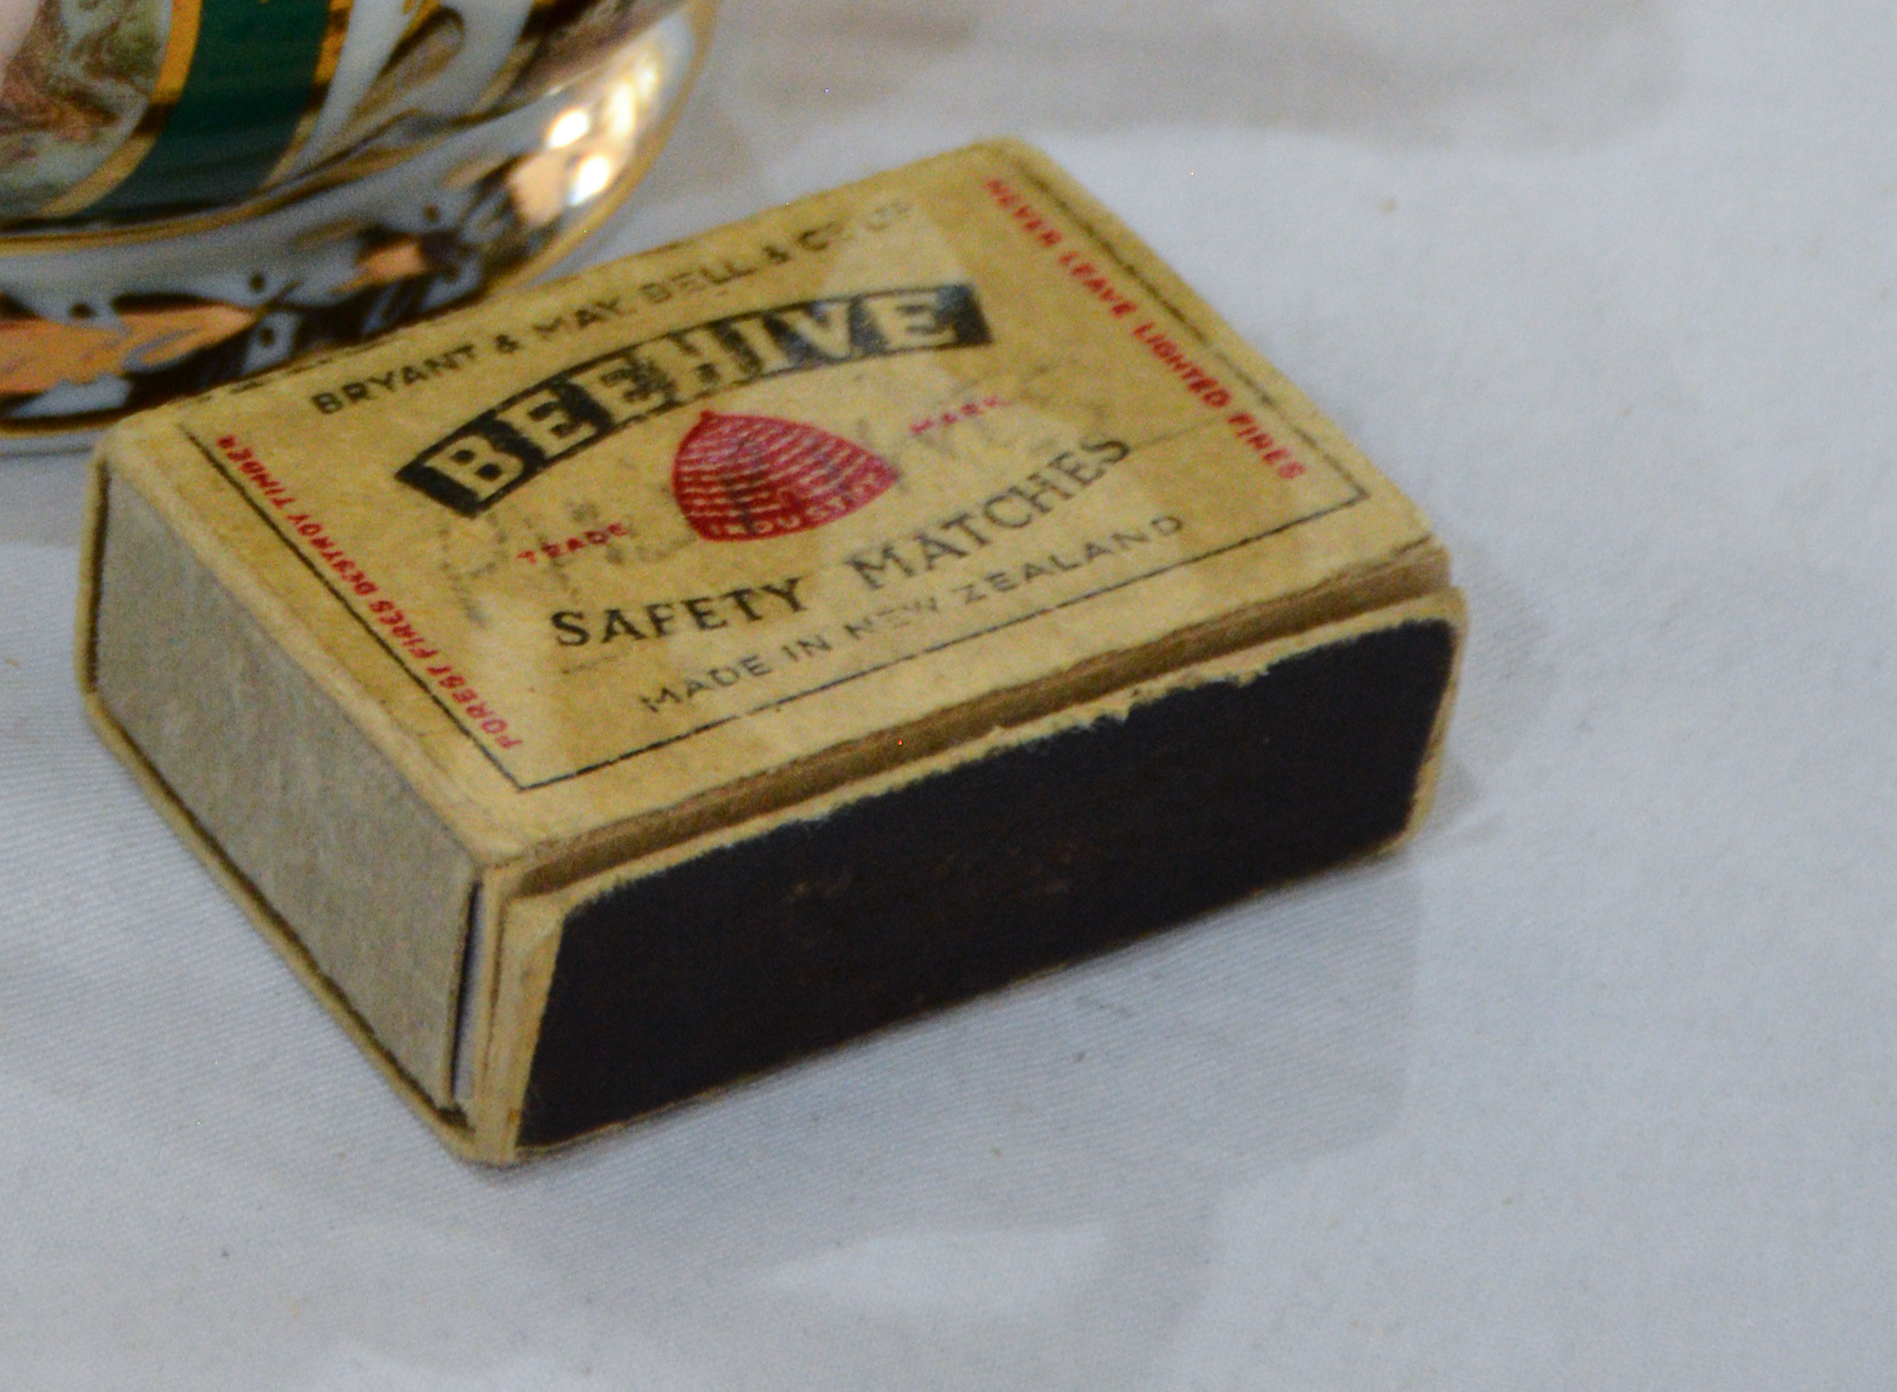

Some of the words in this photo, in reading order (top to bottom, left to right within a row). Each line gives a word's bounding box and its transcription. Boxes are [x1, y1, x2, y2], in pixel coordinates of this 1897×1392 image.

[309, 344, 477, 416] BRYANT
[491, 332, 521, 356] &
[637, 258, 761, 306] BELL
[415, 290, 965, 508] BEEHIVE
[983, 177, 1063, 249] NEVER
[1058, 249, 1139, 320] LEAVE
[1132, 320, 1231, 408] LIGHTED
[1226, 411, 1306, 480] FIRES
[215, 432, 298, 510] TIMBER
[549, 576, 809, 650] SAFETY
[843, 435, 1133, 593] MATCHES
[284, 512, 380, 598] DESTROY
[367, 598, 440, 660] FIRES
[639, 654, 773, 716] MADE
[784, 632, 831, 664] IN
[841, 596, 943, 640] NEW
[953, 514, 1187, 608] ZEALAND
[425, 666, 524, 750] FOREST
